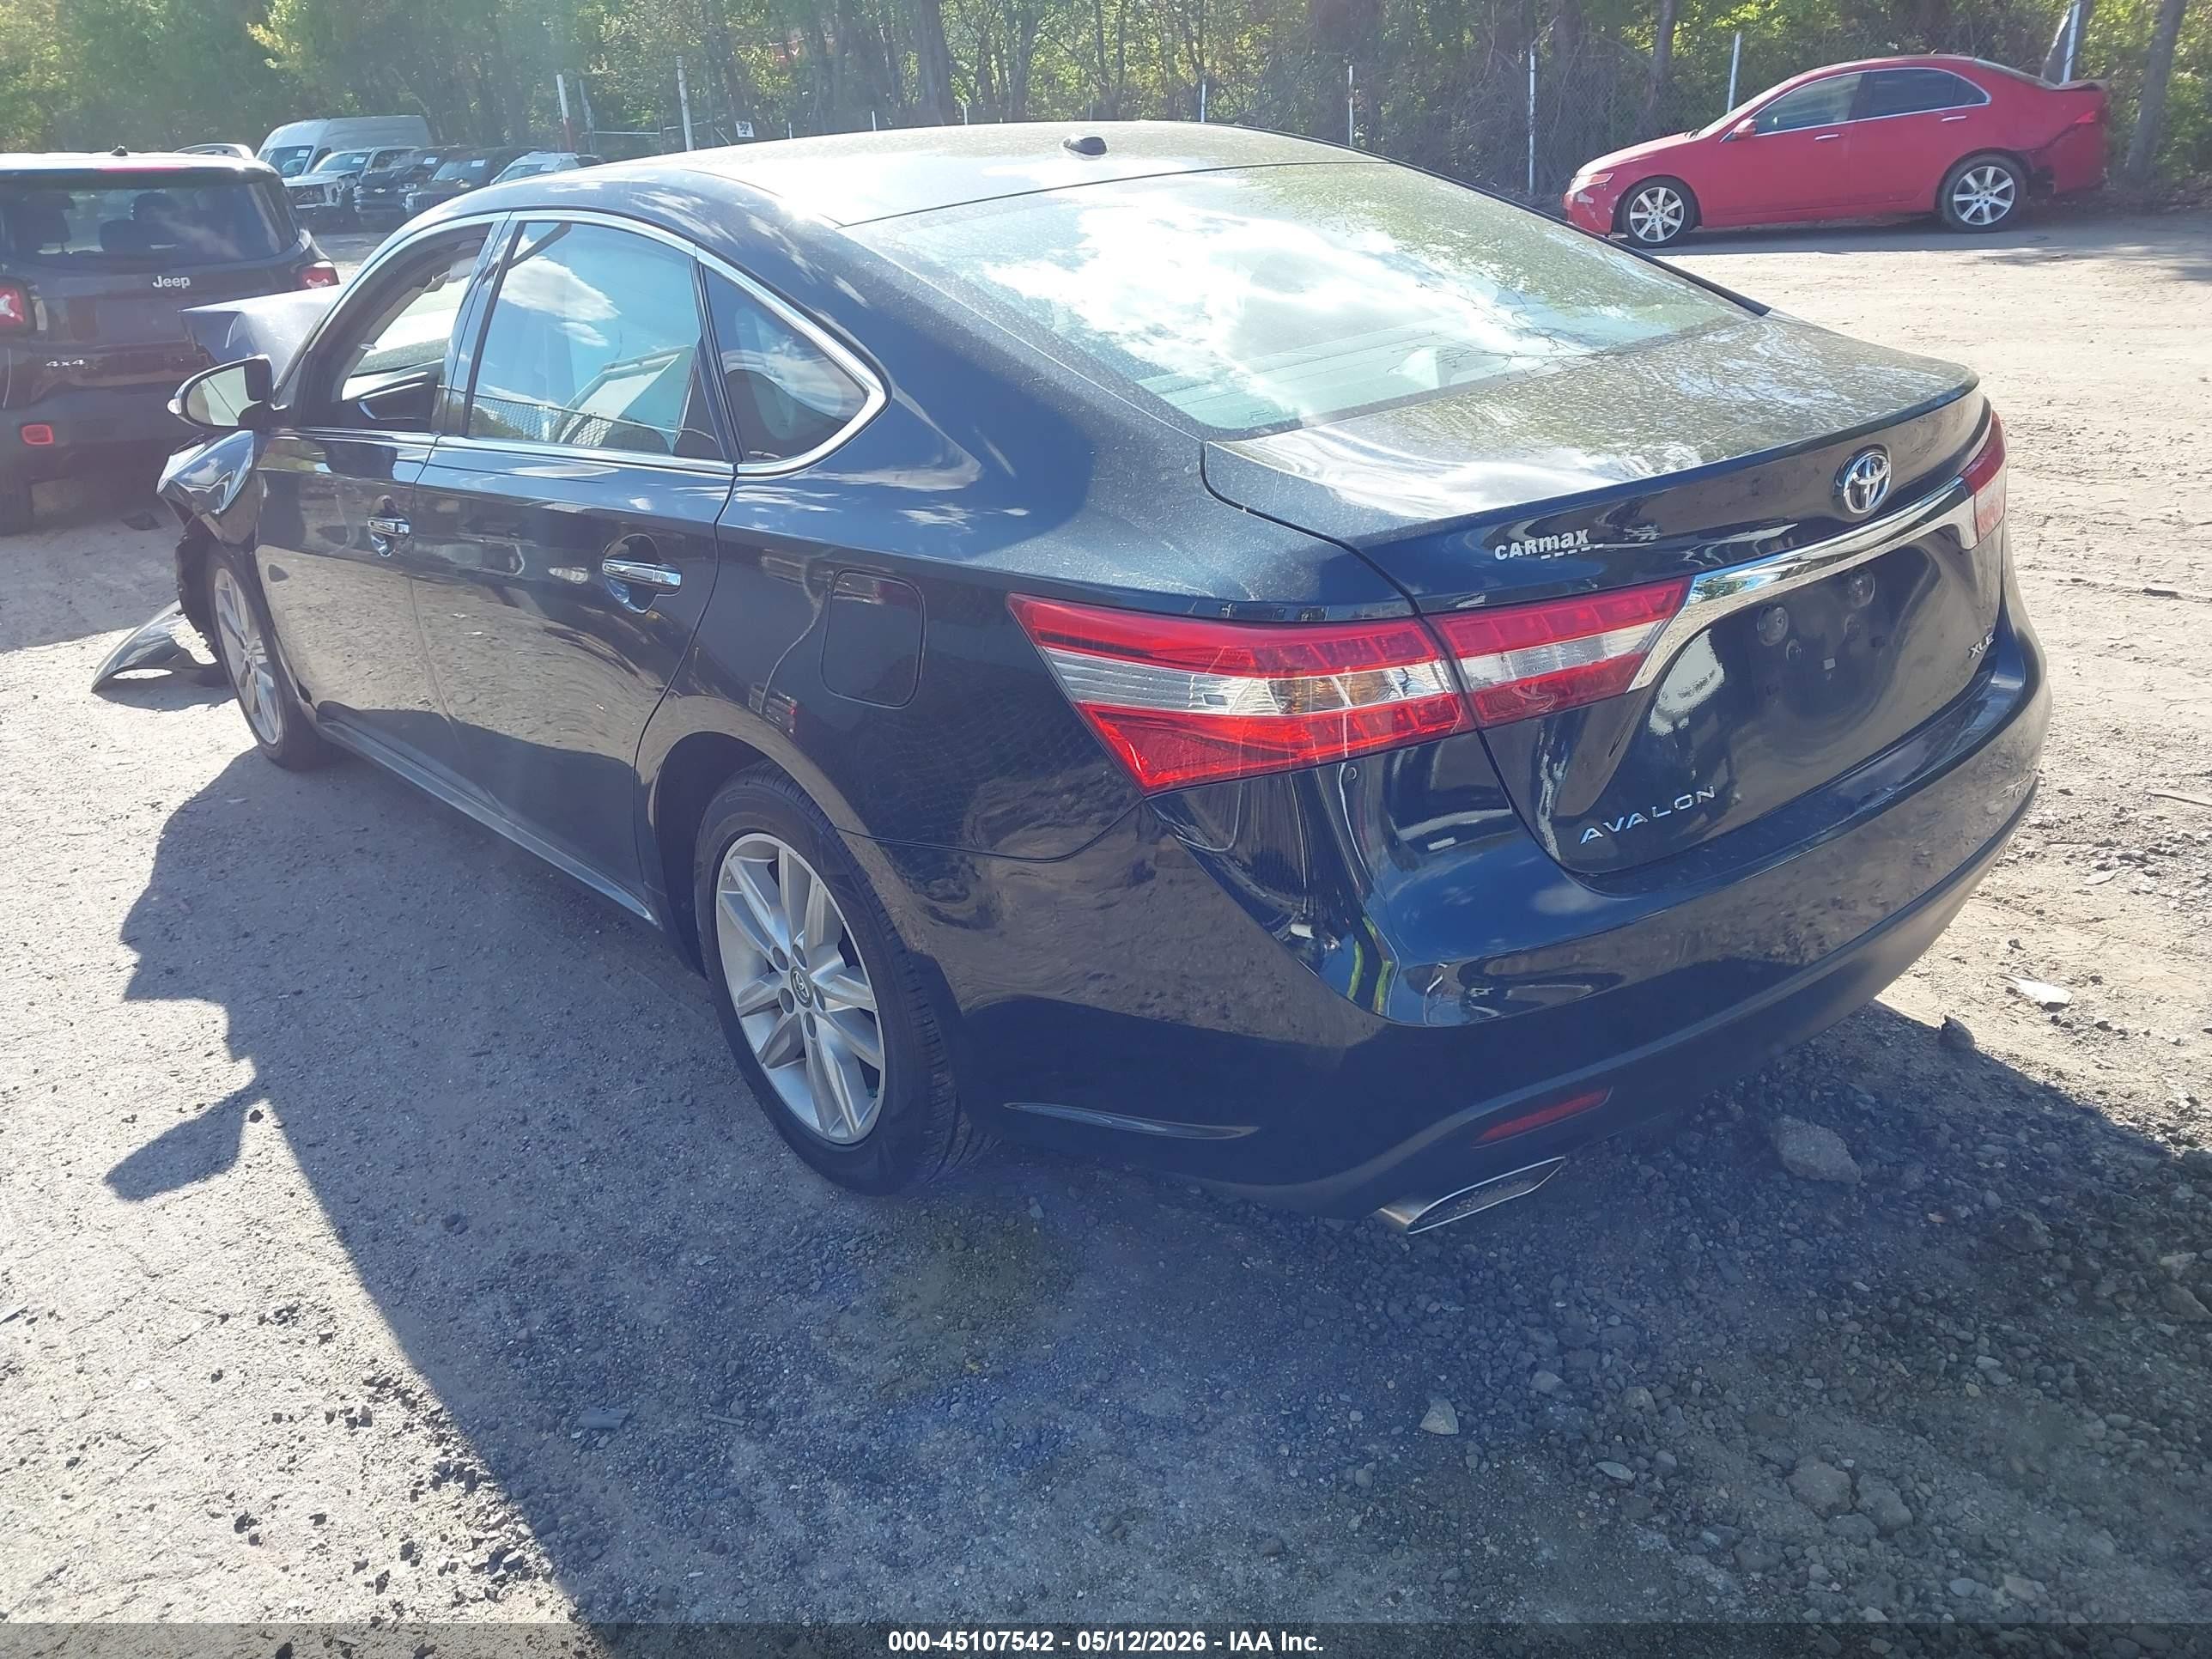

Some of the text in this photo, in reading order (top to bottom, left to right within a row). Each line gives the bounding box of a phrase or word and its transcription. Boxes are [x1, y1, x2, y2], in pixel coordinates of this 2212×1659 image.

[152, 275, 191, 289] Jeep
[46, 359, 86, 368] 4x4
[1969, 632, 1995, 659] XLE
[1580, 786, 1717, 845] AVALON
